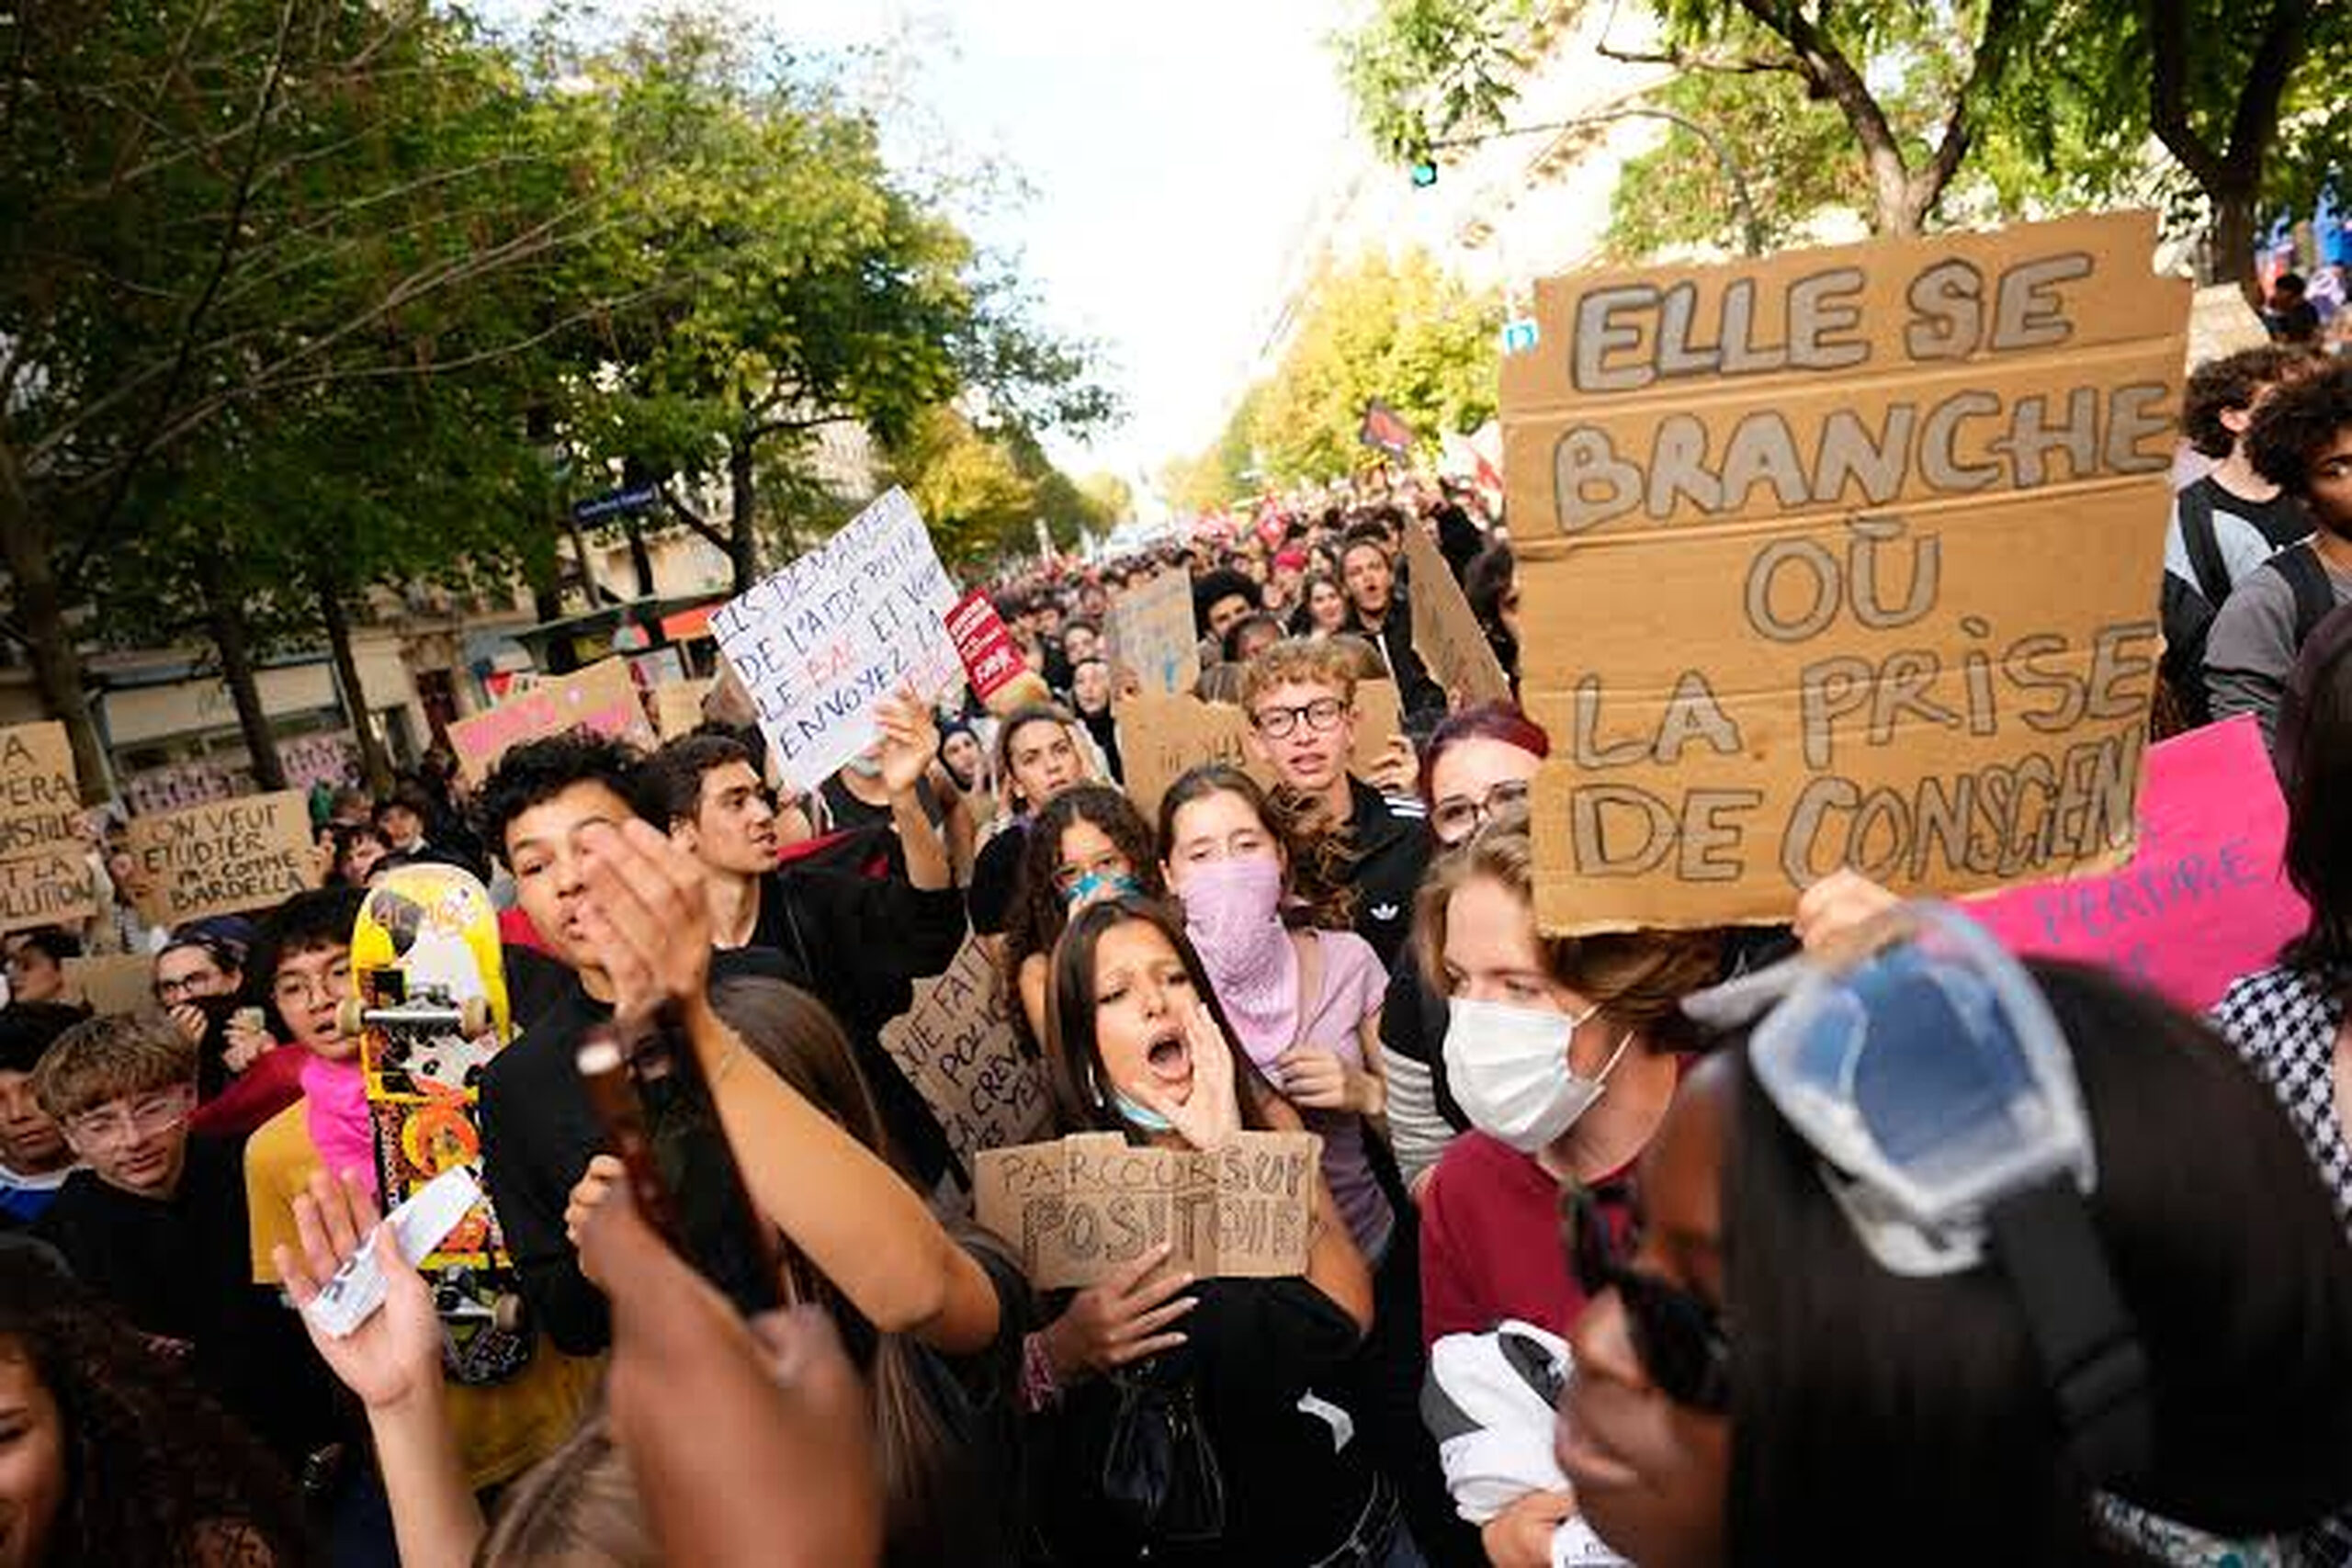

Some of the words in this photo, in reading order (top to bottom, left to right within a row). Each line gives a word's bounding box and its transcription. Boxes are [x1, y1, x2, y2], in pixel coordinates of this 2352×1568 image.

[1572, 268, 1875, 394] ELLE
[1905, 253, 2093, 362] SE
[1554, 381, 2176, 535] BRANCHE
[733, 637, 780, 685] DE
[780, 646, 910, 761] ENVOYEZ
[1573, 669, 1744, 770] LA
[1570, 784, 1762, 883] DE
